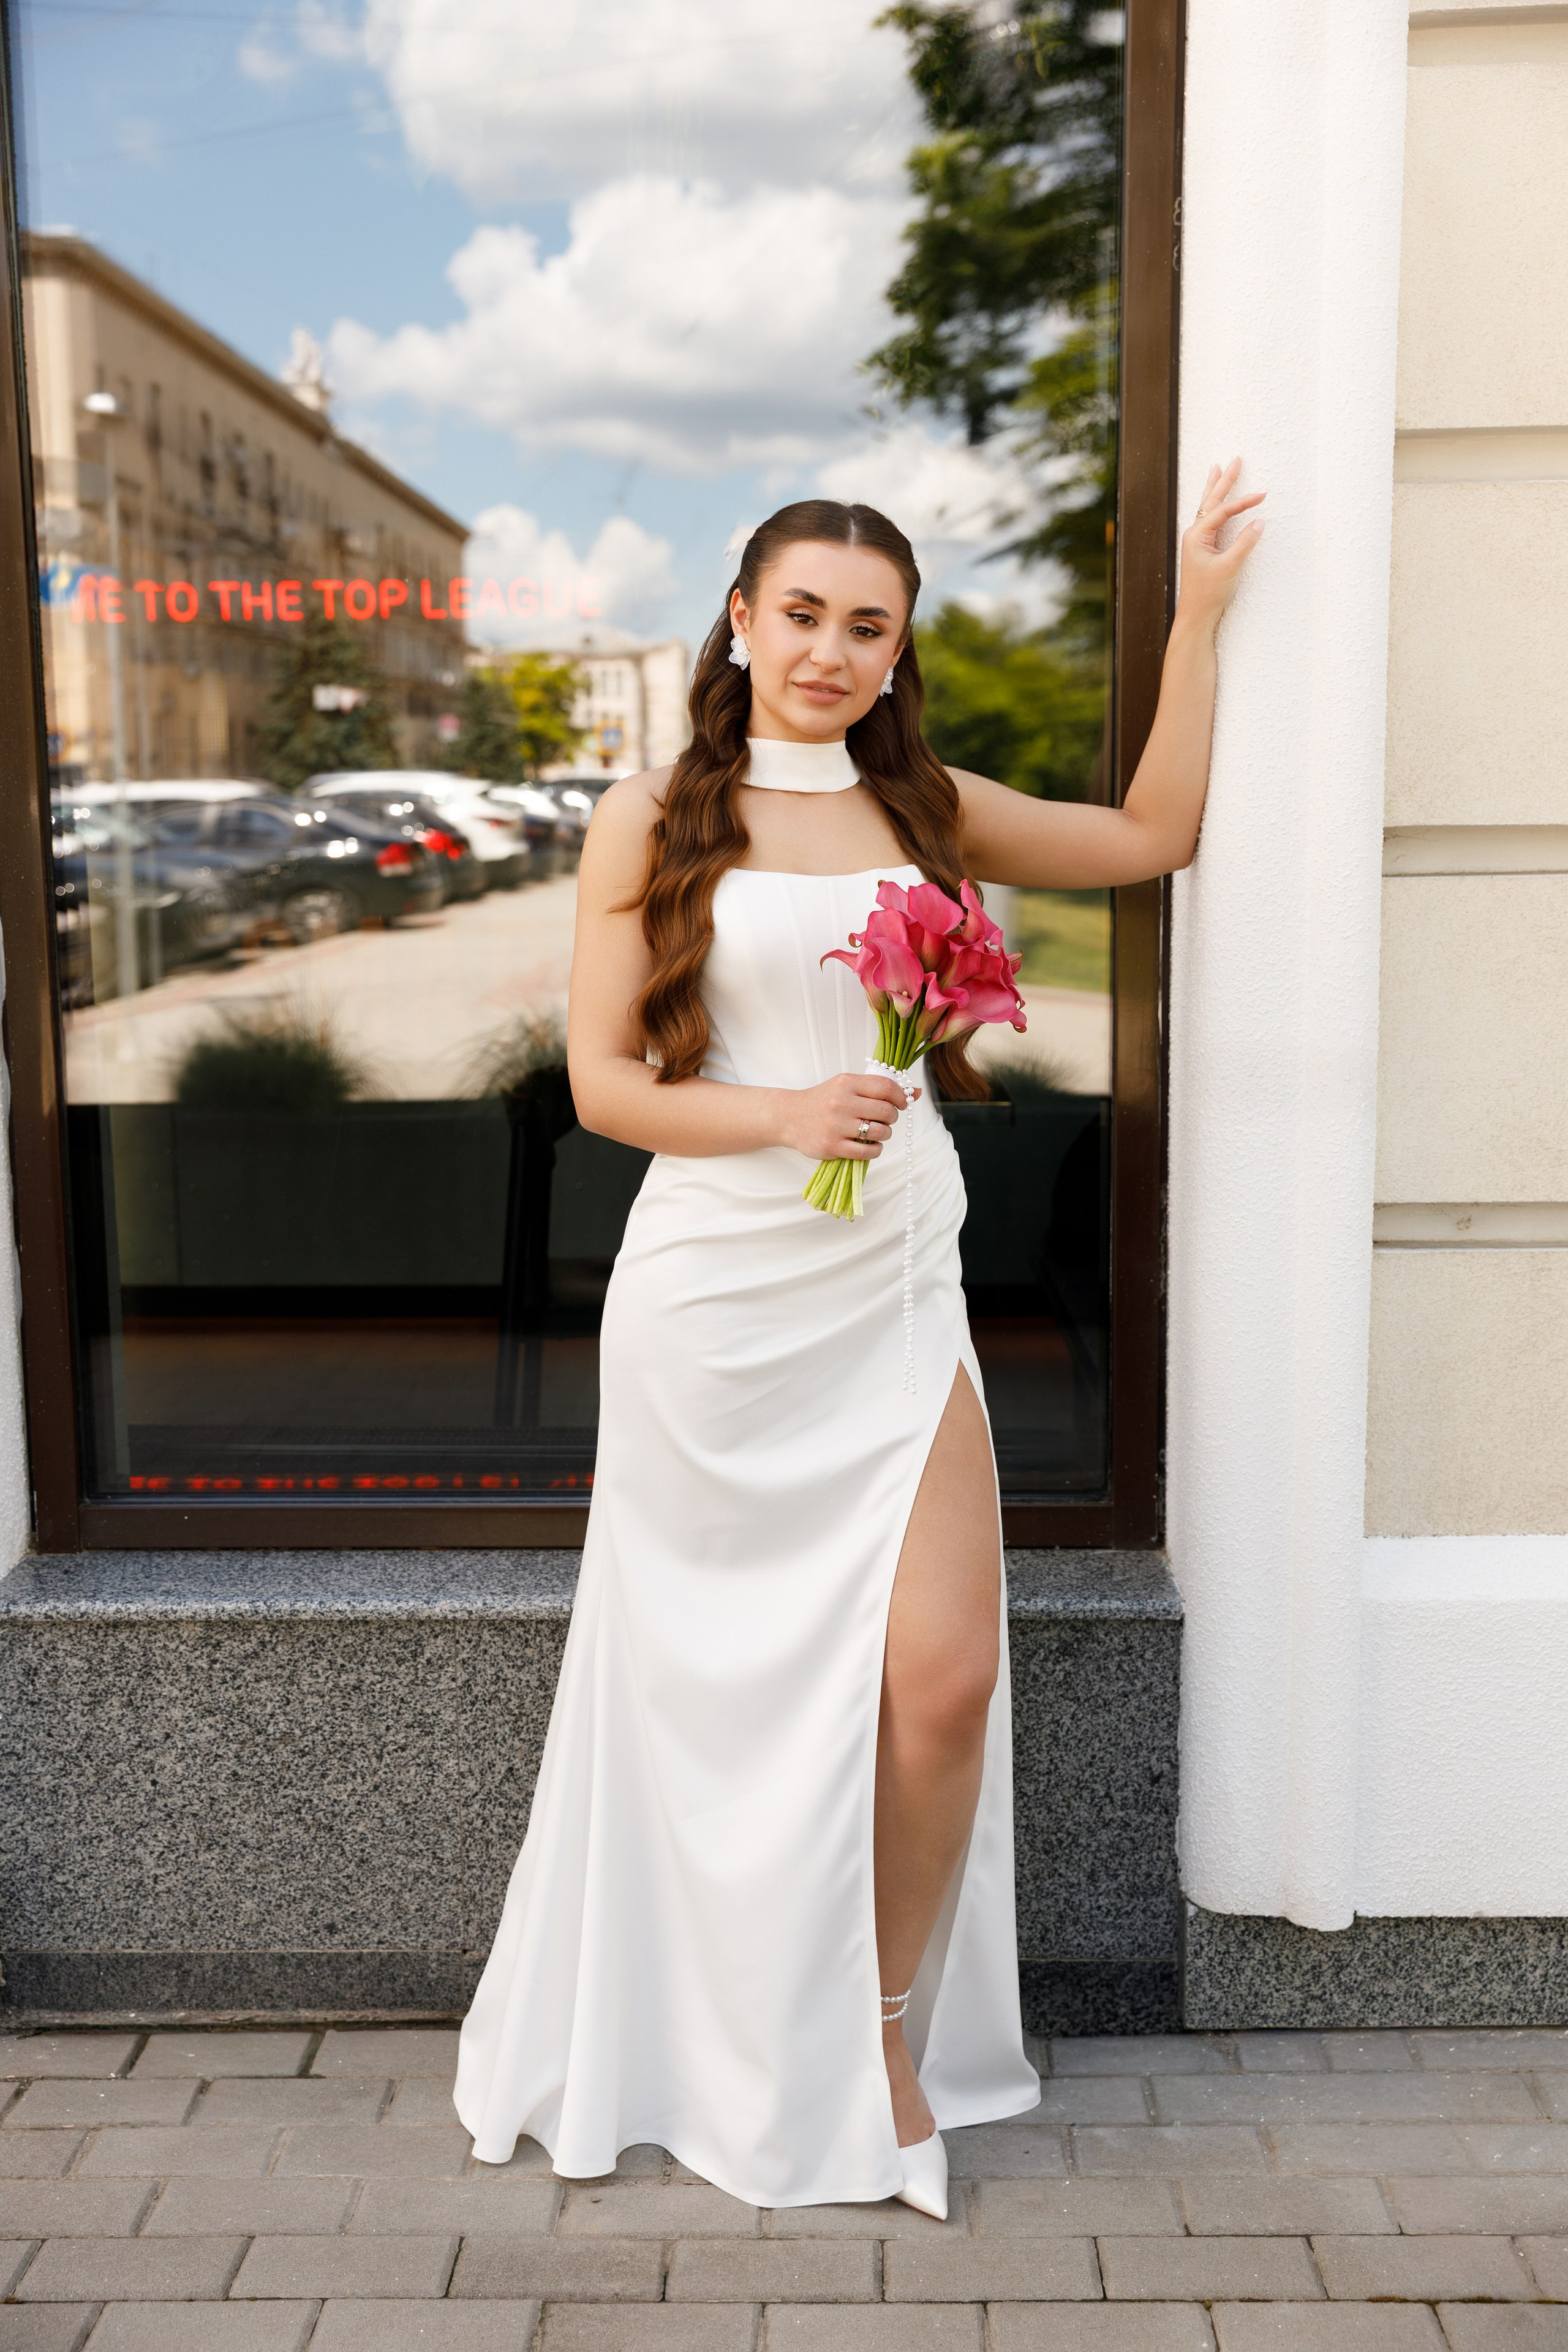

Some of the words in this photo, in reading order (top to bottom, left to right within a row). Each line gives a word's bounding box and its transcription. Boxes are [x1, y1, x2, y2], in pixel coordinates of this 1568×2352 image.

[134, 579, 198, 623] TO
[208, 580, 304, 622] THE
[312, 579, 408, 620] TOP
[420, 576, 604, 619] LEAGUE
